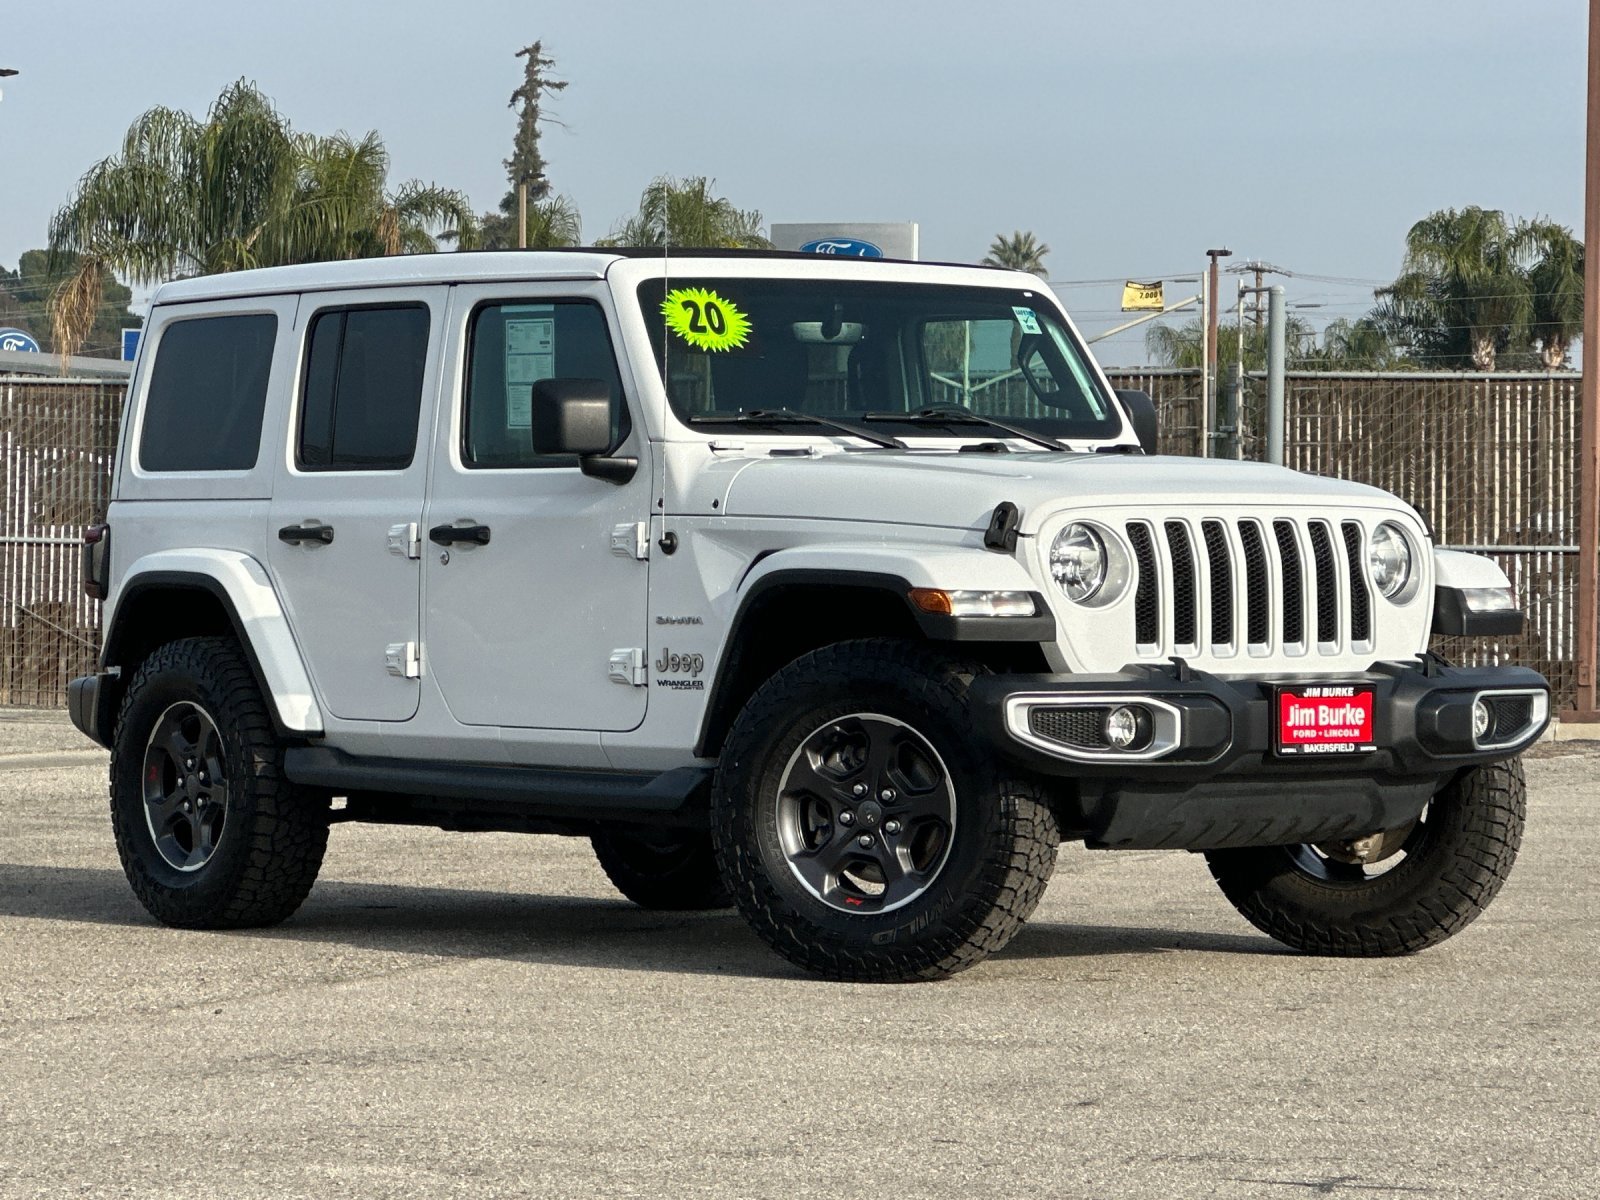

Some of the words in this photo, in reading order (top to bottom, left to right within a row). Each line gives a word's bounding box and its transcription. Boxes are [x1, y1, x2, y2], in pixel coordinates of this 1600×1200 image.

[681, 300, 726, 335] 20
[656, 616, 703, 625] SAHARA
[656, 647, 704, 678] Jeep
[1303, 687, 1321, 698] JIM
[1322, 687, 1355, 698] BURKE
[1287, 704, 1316, 727] Jim
[1318, 703, 1366, 726] Burke
[1293, 730, 1316, 738] FORD
[1324, 729, 1360, 738] LINCOLN
[1303, 743, 1355, 753] BAKERSFIELD
